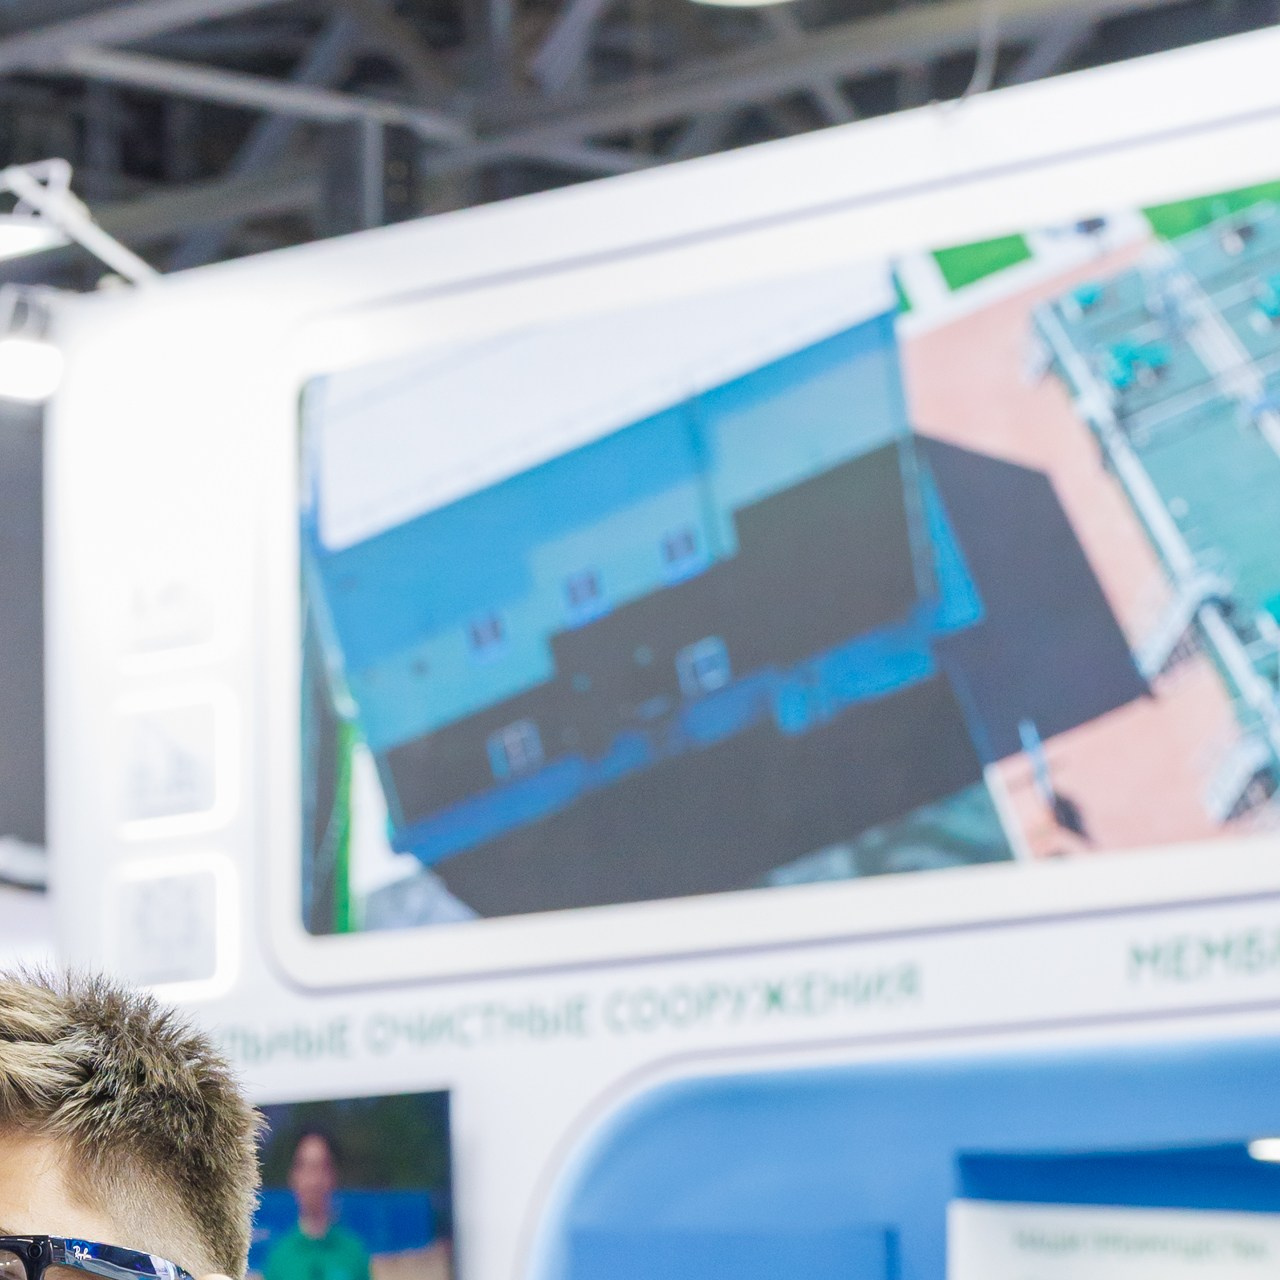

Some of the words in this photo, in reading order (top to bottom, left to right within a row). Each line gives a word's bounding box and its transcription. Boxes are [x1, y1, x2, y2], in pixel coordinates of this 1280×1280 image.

[1127, 924, 1280, 988] МЕМБ
[365, 994, 592, 1056] ОЧИСТНЫЕ
[607, 962, 923, 1034] СООРУЖЕНИЯ
